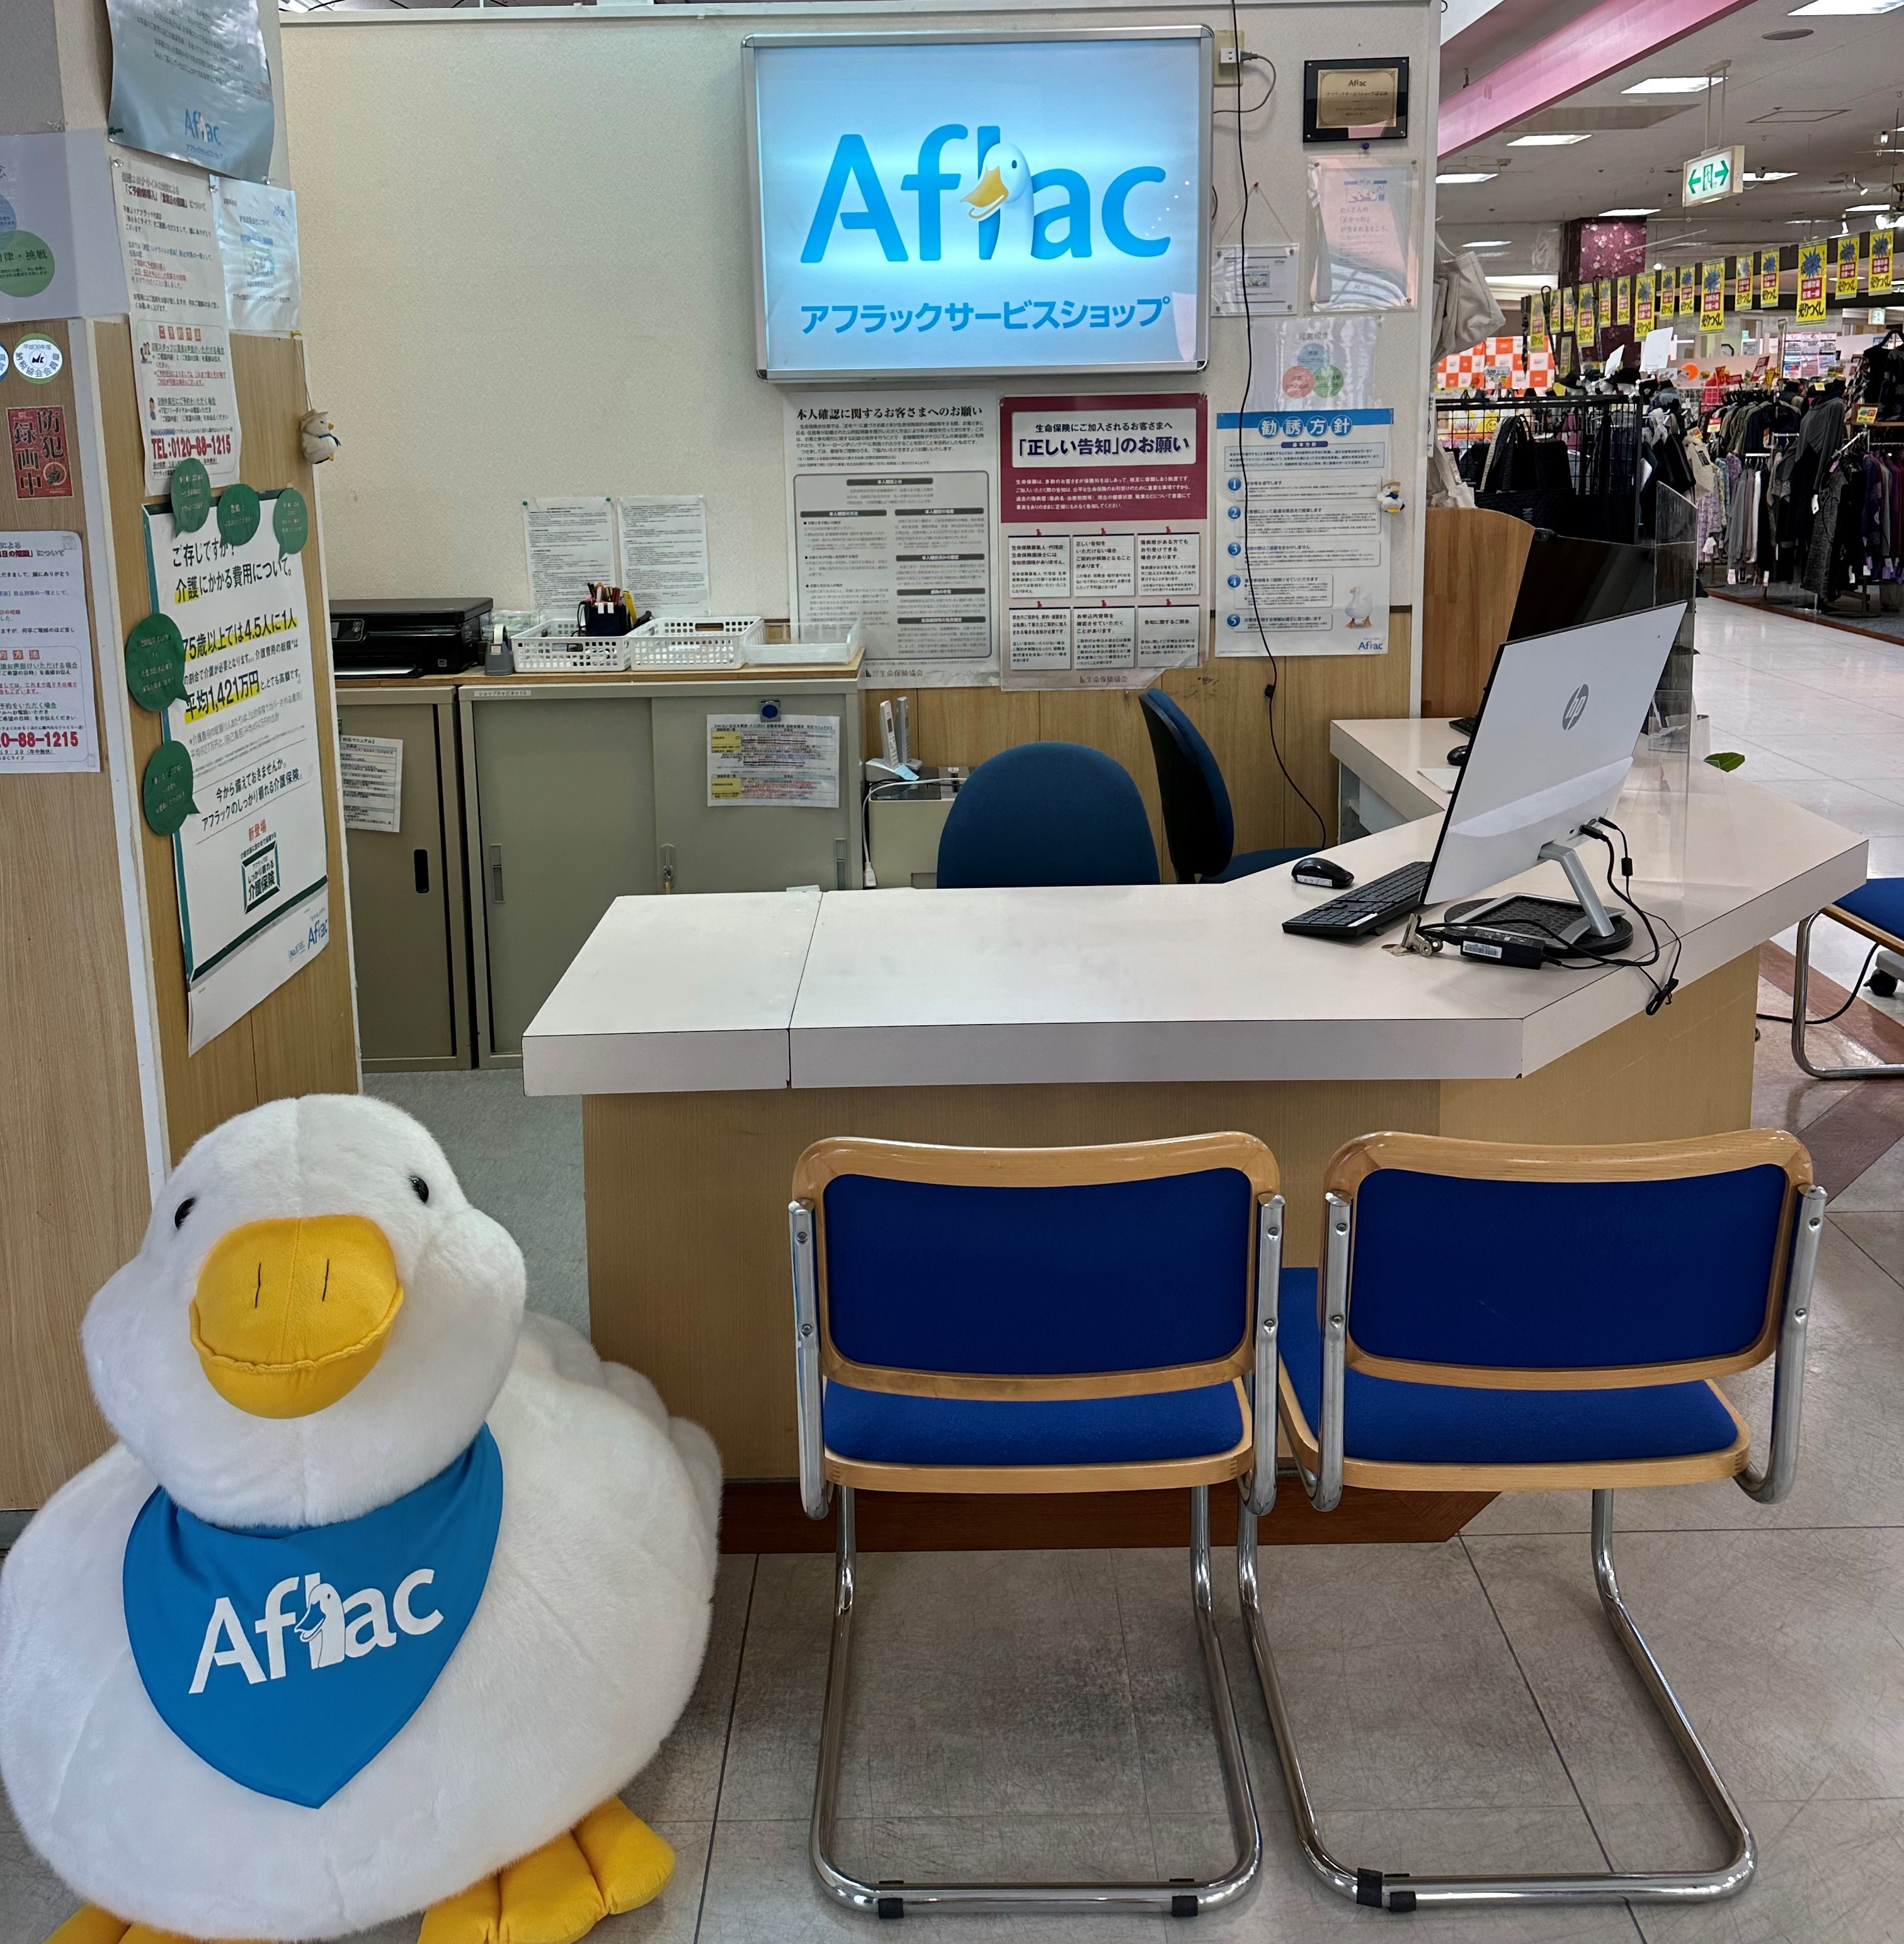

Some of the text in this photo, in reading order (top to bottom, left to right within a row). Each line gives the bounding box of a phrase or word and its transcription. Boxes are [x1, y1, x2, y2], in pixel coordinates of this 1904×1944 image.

[801, 123, 1171, 263] Aflac
[801, 297, 1171, 334] アフラックサービスショップ
[797, 406, 983, 421] 本人確認に関するお客さまへのお願い
[1035, 421, 1173, 433] 生命保険にご加入されるお客さまへ
[1261, 418, 1351, 436] 勧誘方針
[37, 410, 64, 459] 防犯
[1019, 436, 1190, 457] 「正しい告知」のお願い
[13, 421, 42, 496] 録画中
[1231, 480, 1237, 489] 1
[1232, 508, 1238, 518] 2
[1231, 545, 1238, 555] 3
[175, 557, 292, 603] 介護にかかる費用について。
[1231, 577, 1238, 586] 4
[183, 608, 297, 660] 75歳以上では4.5人に1人
[1231, 616, 1237, 625] 5
[1086, 676, 1128, 684] 生命保険協会
[1562, 685, 1589, 730] hp
[215, 758, 287, 802] 今から備えておきませんか。
[202, 768, 303, 831] アフラックのしっかり頼れる介護保険。
[248, 870, 275, 901] 介護保険
[189, 1568, 445, 1695] Aflac
